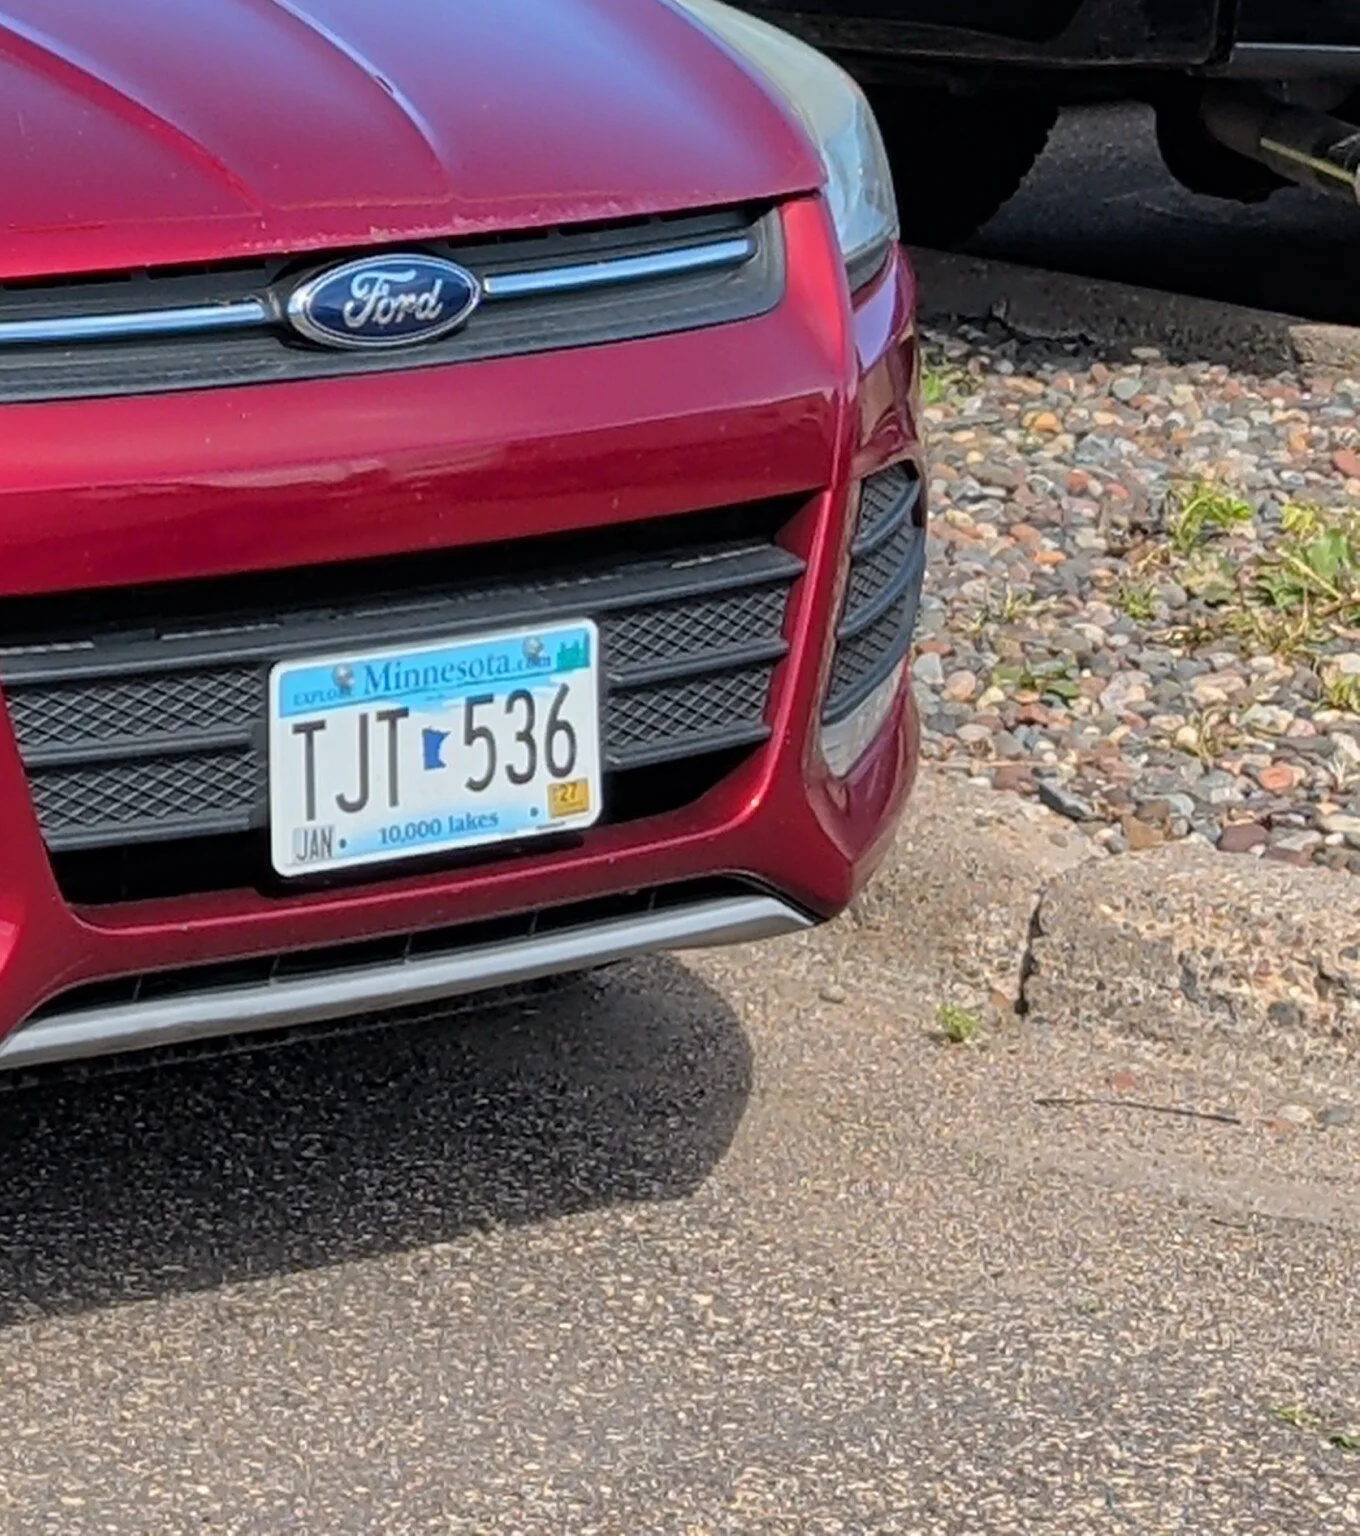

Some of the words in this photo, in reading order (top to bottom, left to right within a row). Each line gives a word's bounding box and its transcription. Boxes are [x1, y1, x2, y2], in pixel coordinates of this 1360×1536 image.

[342, 269, 443, 328] Ford
[292, 707, 410, 822] TJT
[464, 682, 577, 792] 536
[296, 827, 331, 861] JAN
[379, 818, 442, 846] 10,000
[448, 811, 499, 835] lakes
